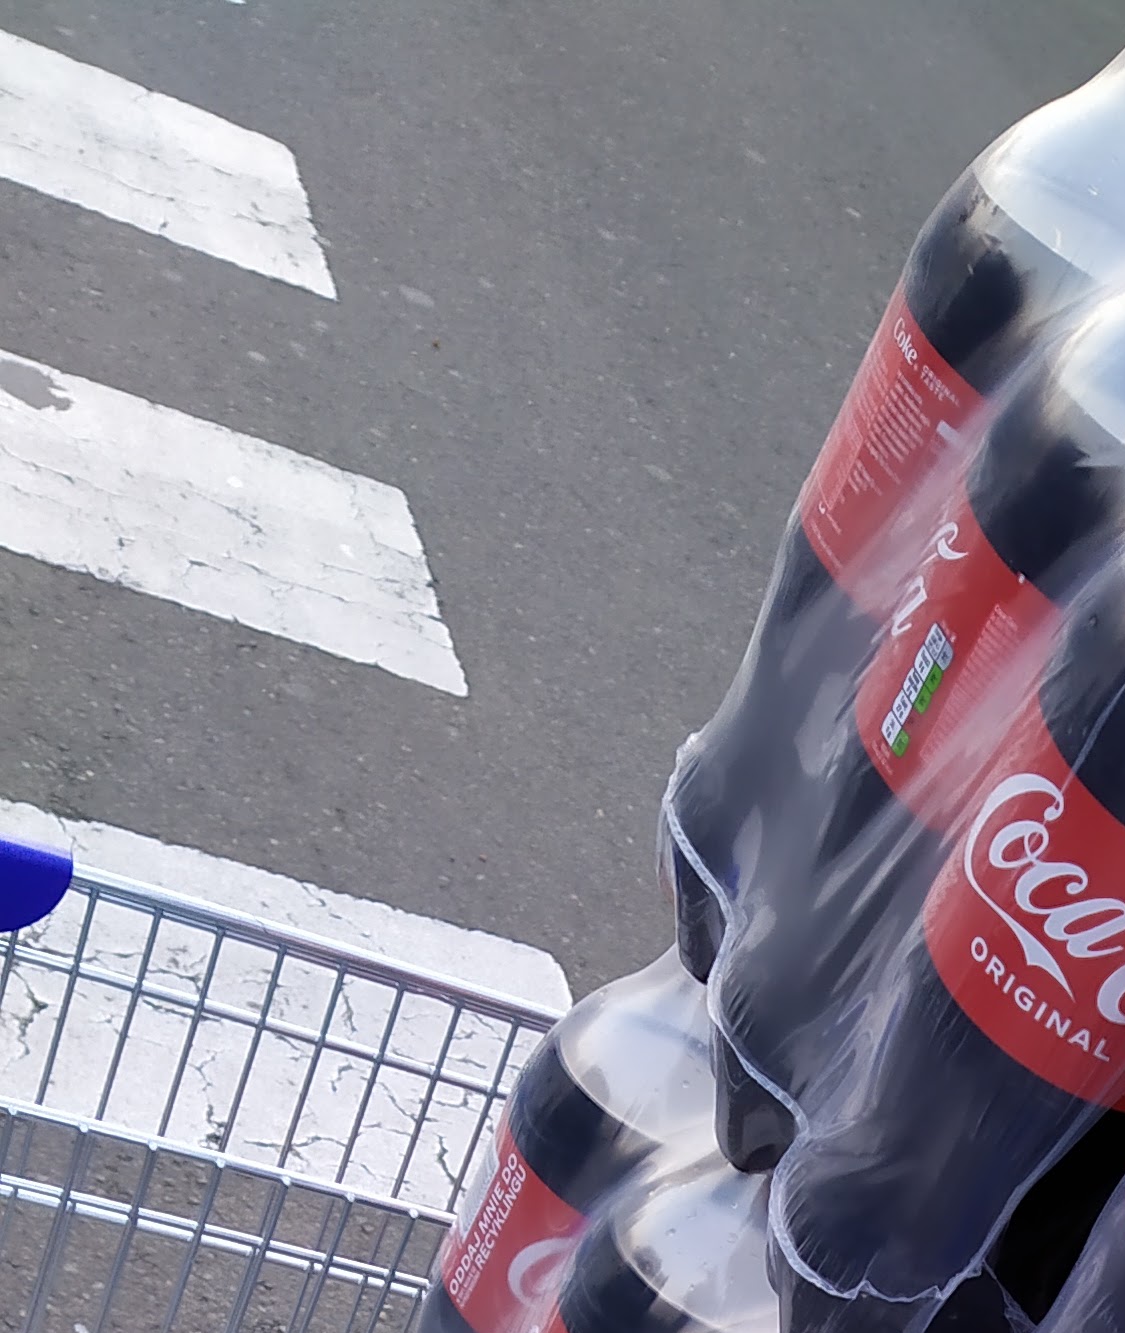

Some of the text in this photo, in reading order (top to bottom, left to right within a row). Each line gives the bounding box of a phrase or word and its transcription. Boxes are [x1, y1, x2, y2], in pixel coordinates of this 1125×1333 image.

[893, 317, 918, 366] Coke
[970, 935, 1110, 1062] ORIGINAL
[449, 1231, 481, 1295] ODDAJ
[477, 1182, 505, 1235] MNIE
[501, 1153, 518, 1185] DO
[474, 1164, 527, 1271] RECYKLINGU
